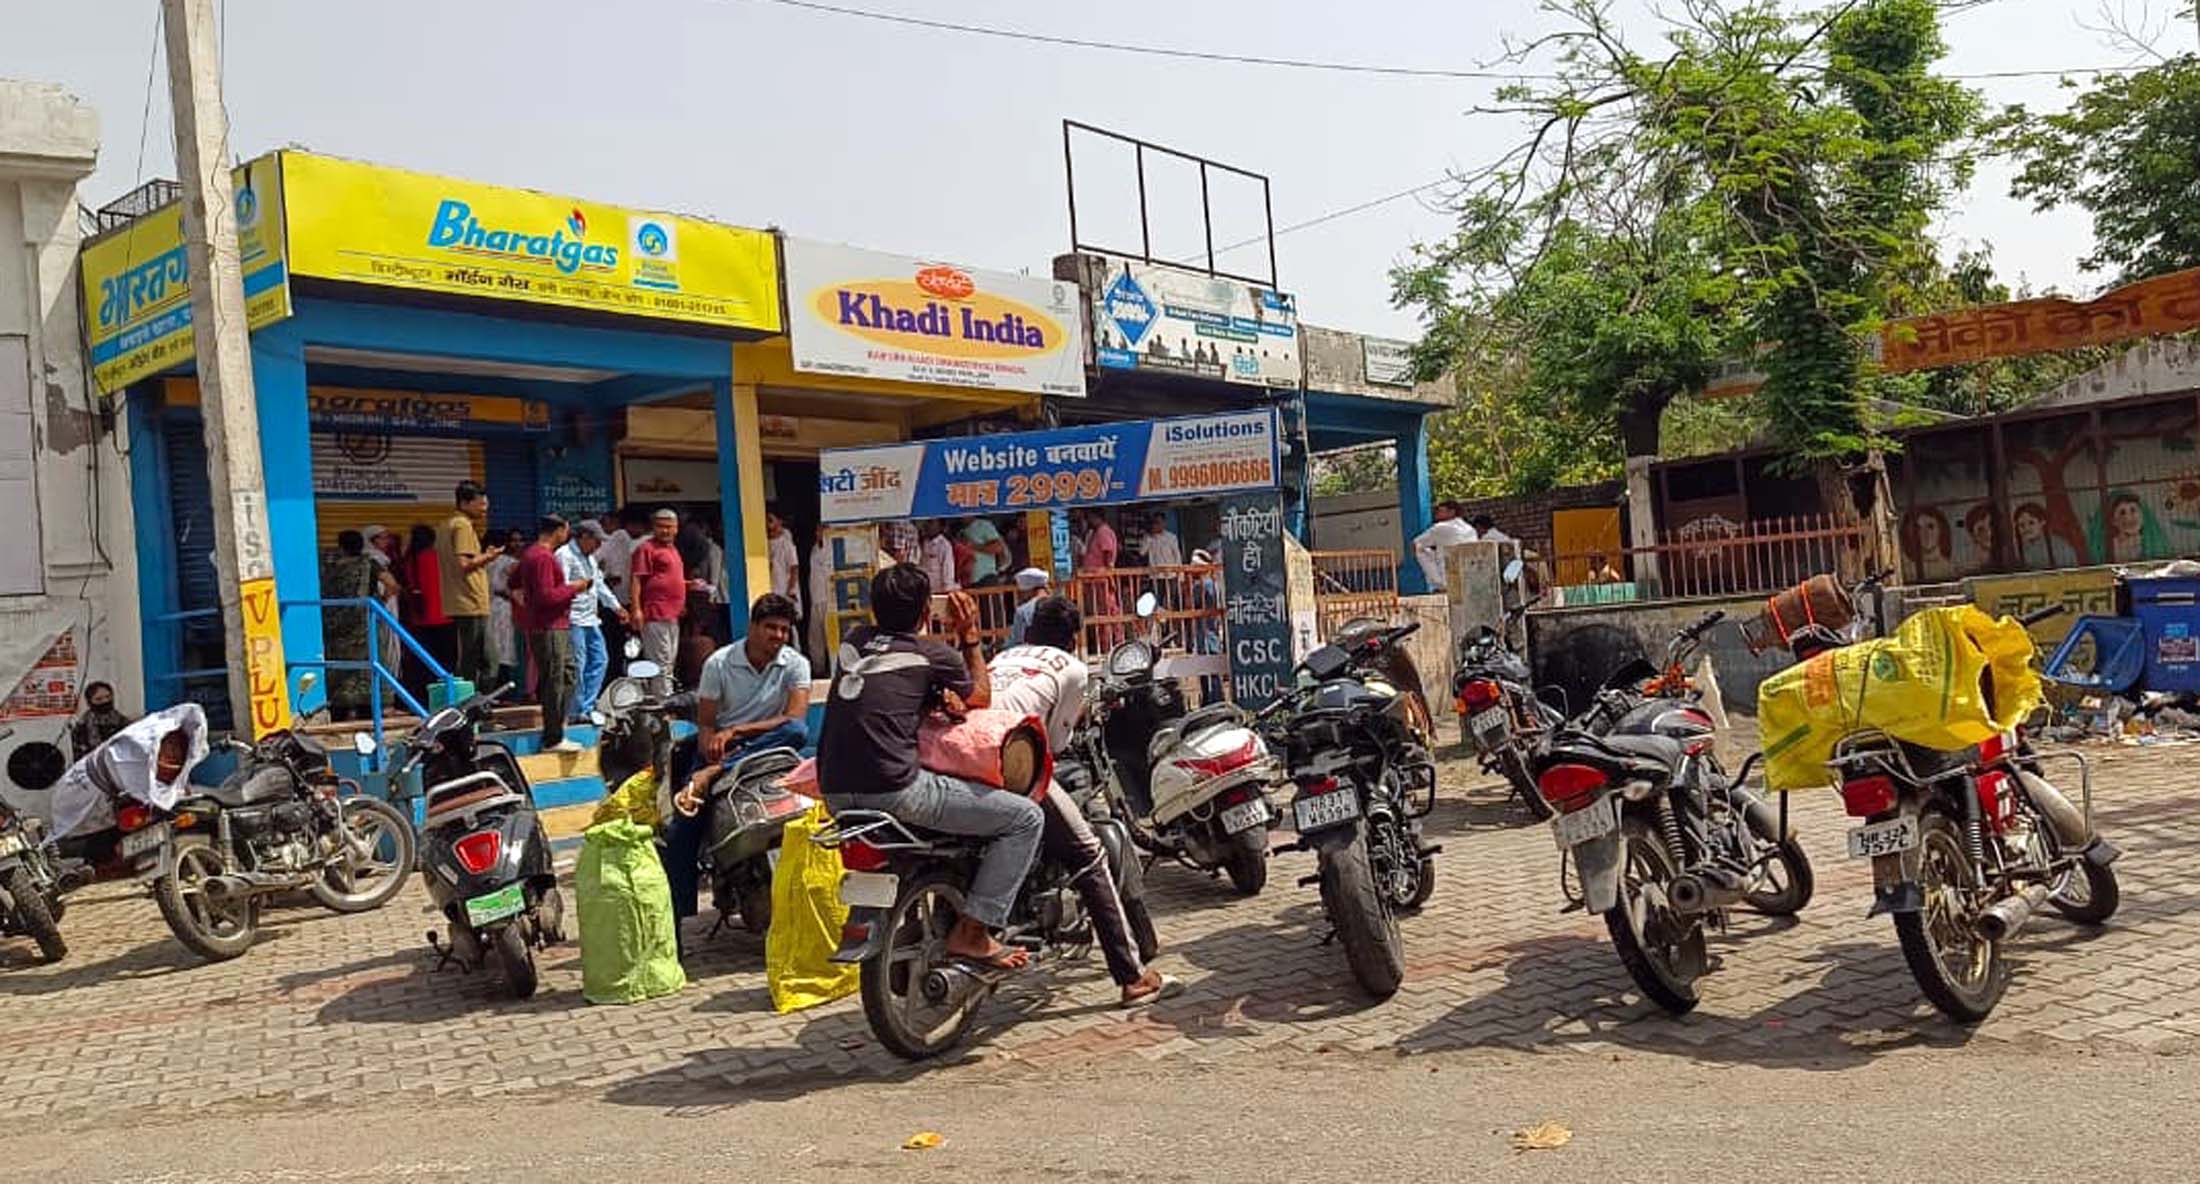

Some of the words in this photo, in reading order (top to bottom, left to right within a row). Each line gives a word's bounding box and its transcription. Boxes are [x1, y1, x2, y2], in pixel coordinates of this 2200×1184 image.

[429, 200, 618, 273] Bharatgas
[98, 244, 190, 328] भारतग
[838, 290, 951, 338] Khadi
[961, 307, 1045, 349] India
[1165, 421, 1264, 442] iSolutions
[944, 444, 1038, 473] Website
[1005, 465, 1127, 507] 2999/-
[1242, 540, 1263, 573] ही
[1237, 638, 1282, 666] CSC
